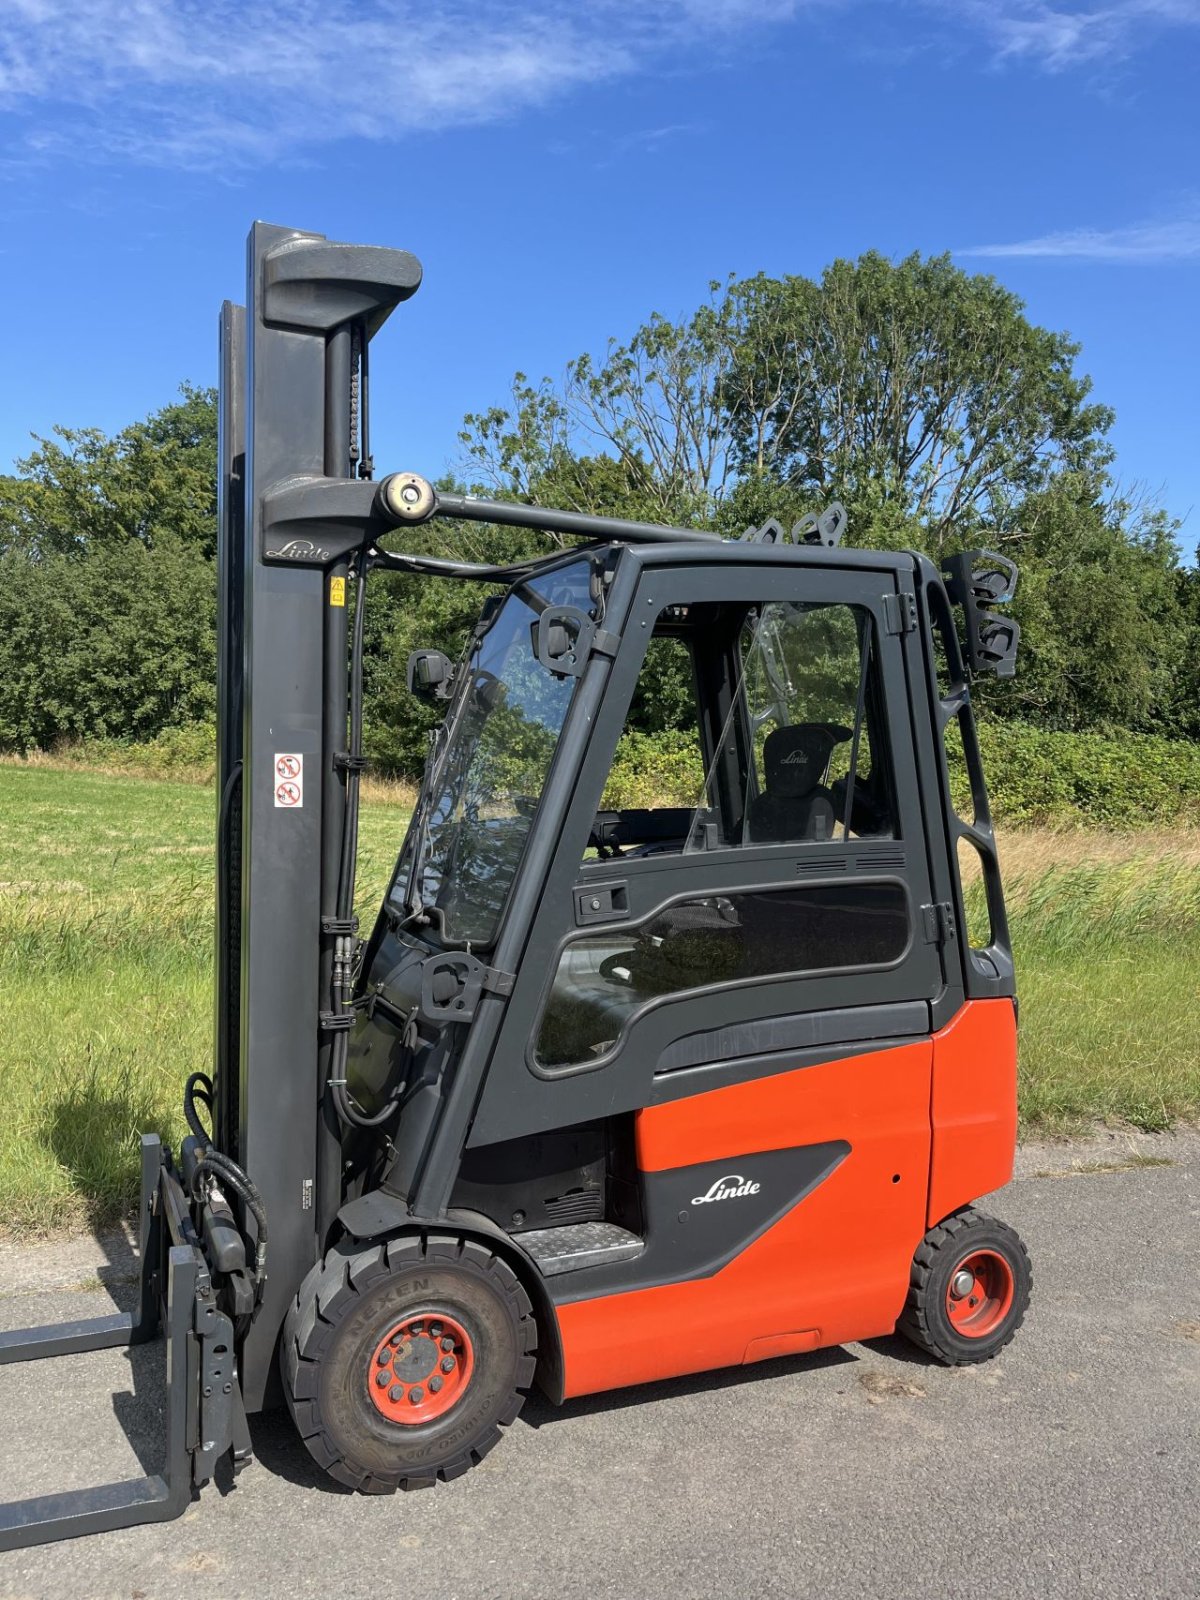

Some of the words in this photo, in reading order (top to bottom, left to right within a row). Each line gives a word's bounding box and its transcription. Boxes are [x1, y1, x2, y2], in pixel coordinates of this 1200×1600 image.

[265, 540, 330, 561] Linde
[691, 1175, 761, 1206] Linde
[349, 1277, 430, 1338] NEXEN
